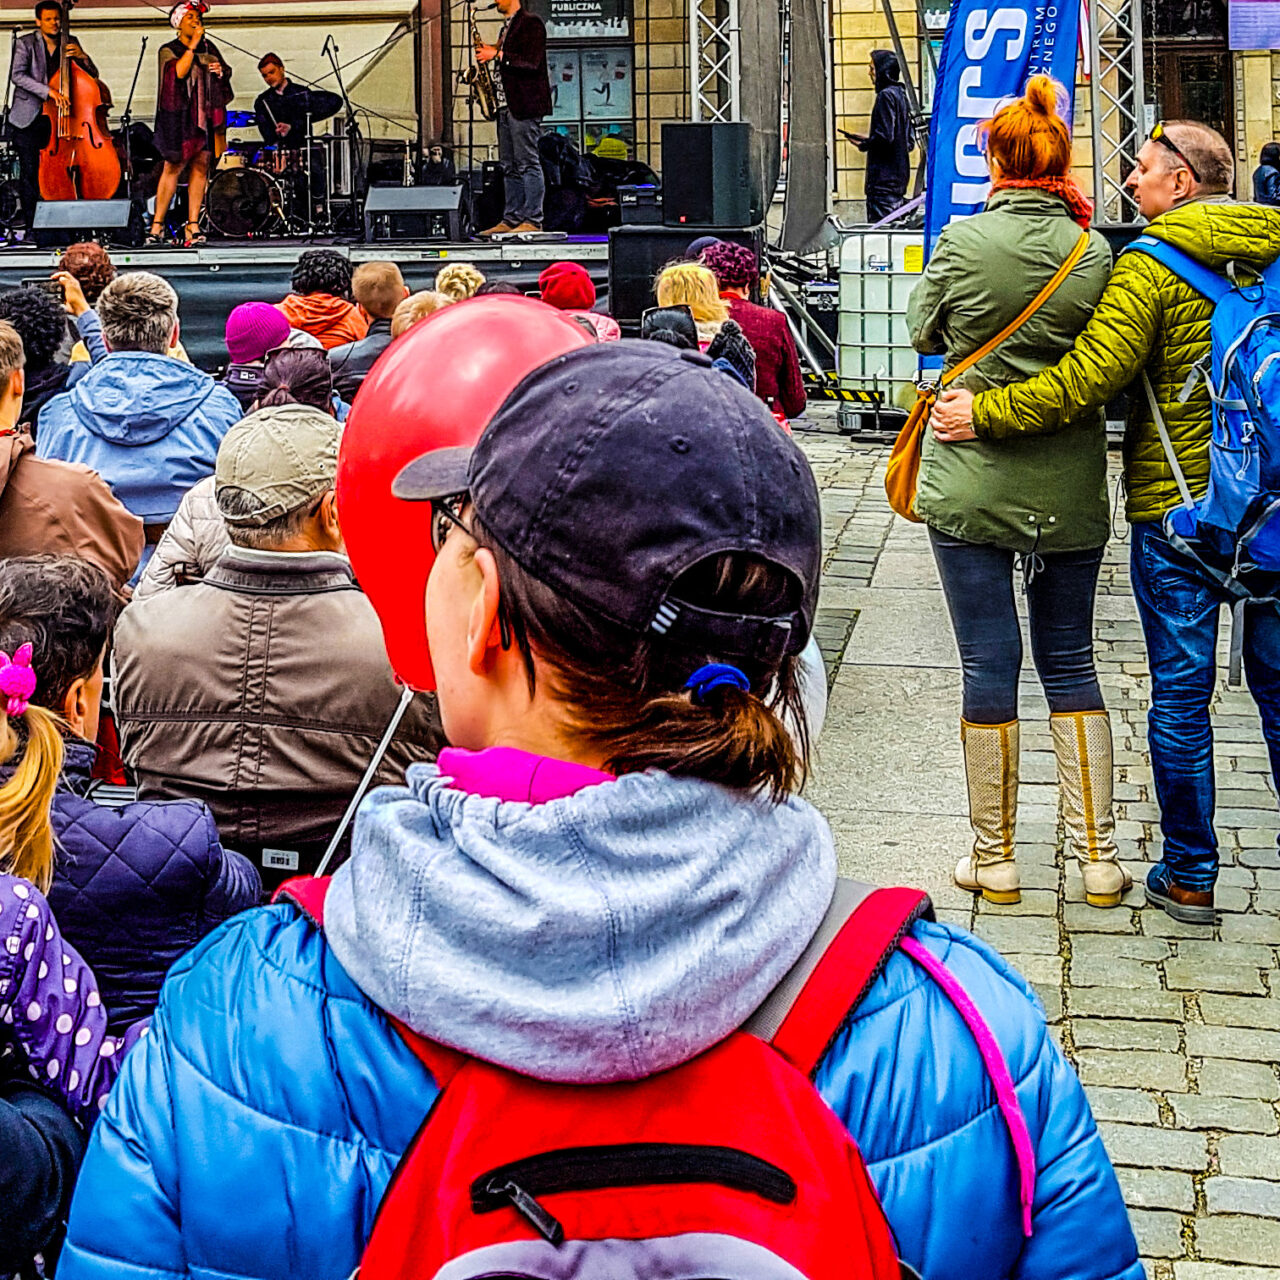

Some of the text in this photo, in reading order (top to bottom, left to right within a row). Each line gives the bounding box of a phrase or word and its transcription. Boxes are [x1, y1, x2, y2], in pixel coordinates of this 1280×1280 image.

[551, 2, 602, 11] PUBLICZNA
[1028, 6, 1046, 76] NTRUM
[1041, 6, 1058, 75] ZNEGO
